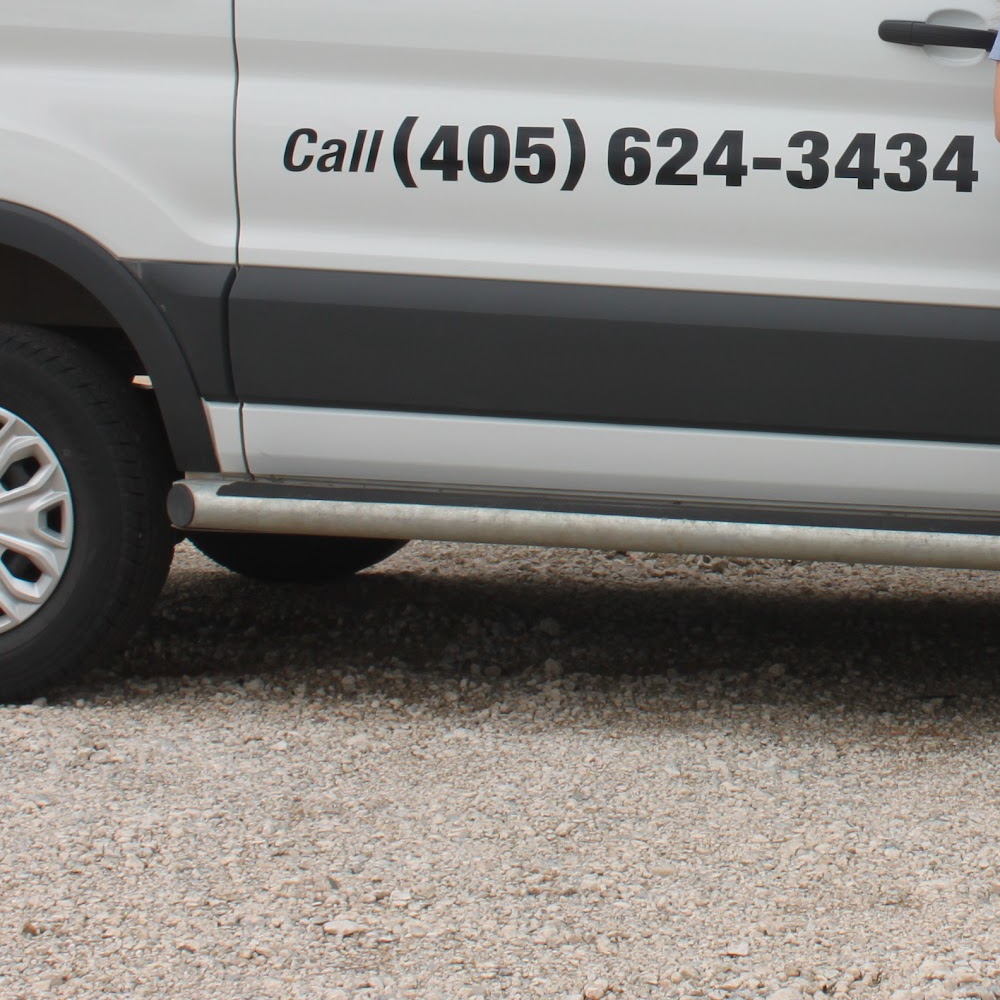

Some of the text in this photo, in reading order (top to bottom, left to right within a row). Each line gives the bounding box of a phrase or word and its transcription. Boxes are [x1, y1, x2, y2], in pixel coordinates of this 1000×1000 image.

[283, 115, 979, 193] Call (405) 624-3434
